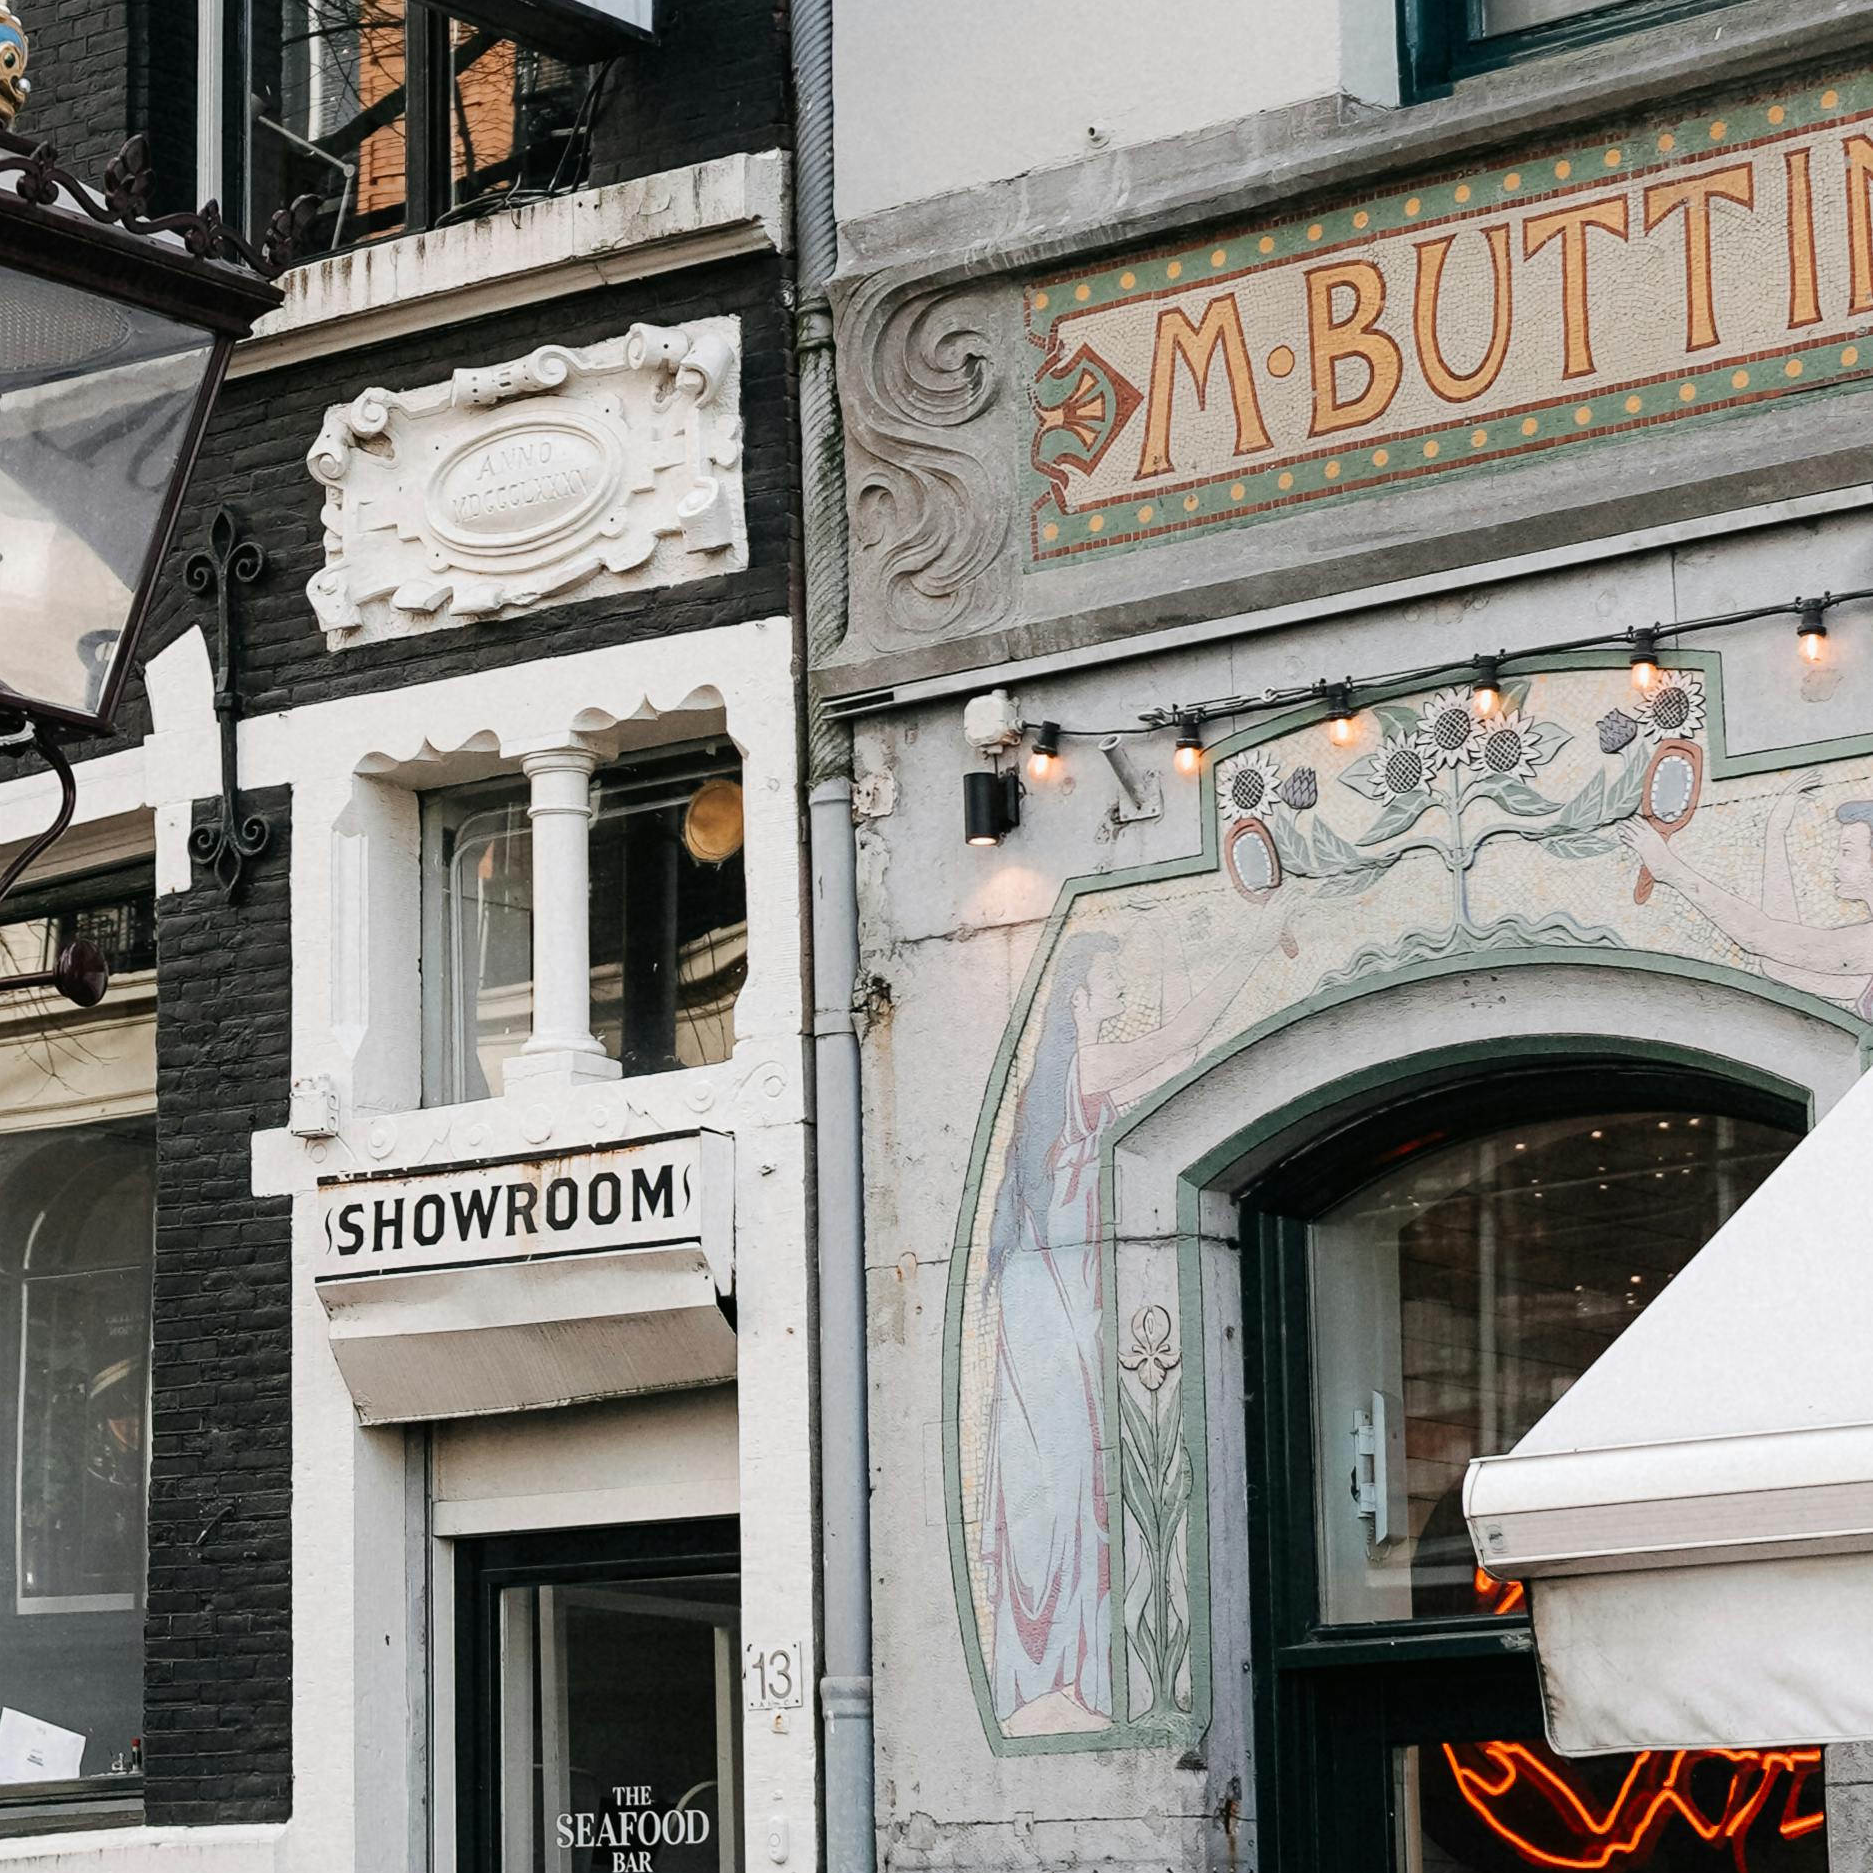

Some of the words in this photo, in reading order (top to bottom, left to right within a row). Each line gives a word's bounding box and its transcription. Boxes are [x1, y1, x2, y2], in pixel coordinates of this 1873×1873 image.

[476, 441, 552, 481] ANNO
[336, 1164, 675, 1257] SHOWROOM
[752, 1650, 792, 1700] 13
[612, 1785, 653, 1807] THE
[556, 1809, 710, 1848] SEAFOOD
[612, 1851, 654, 1873] BAR
